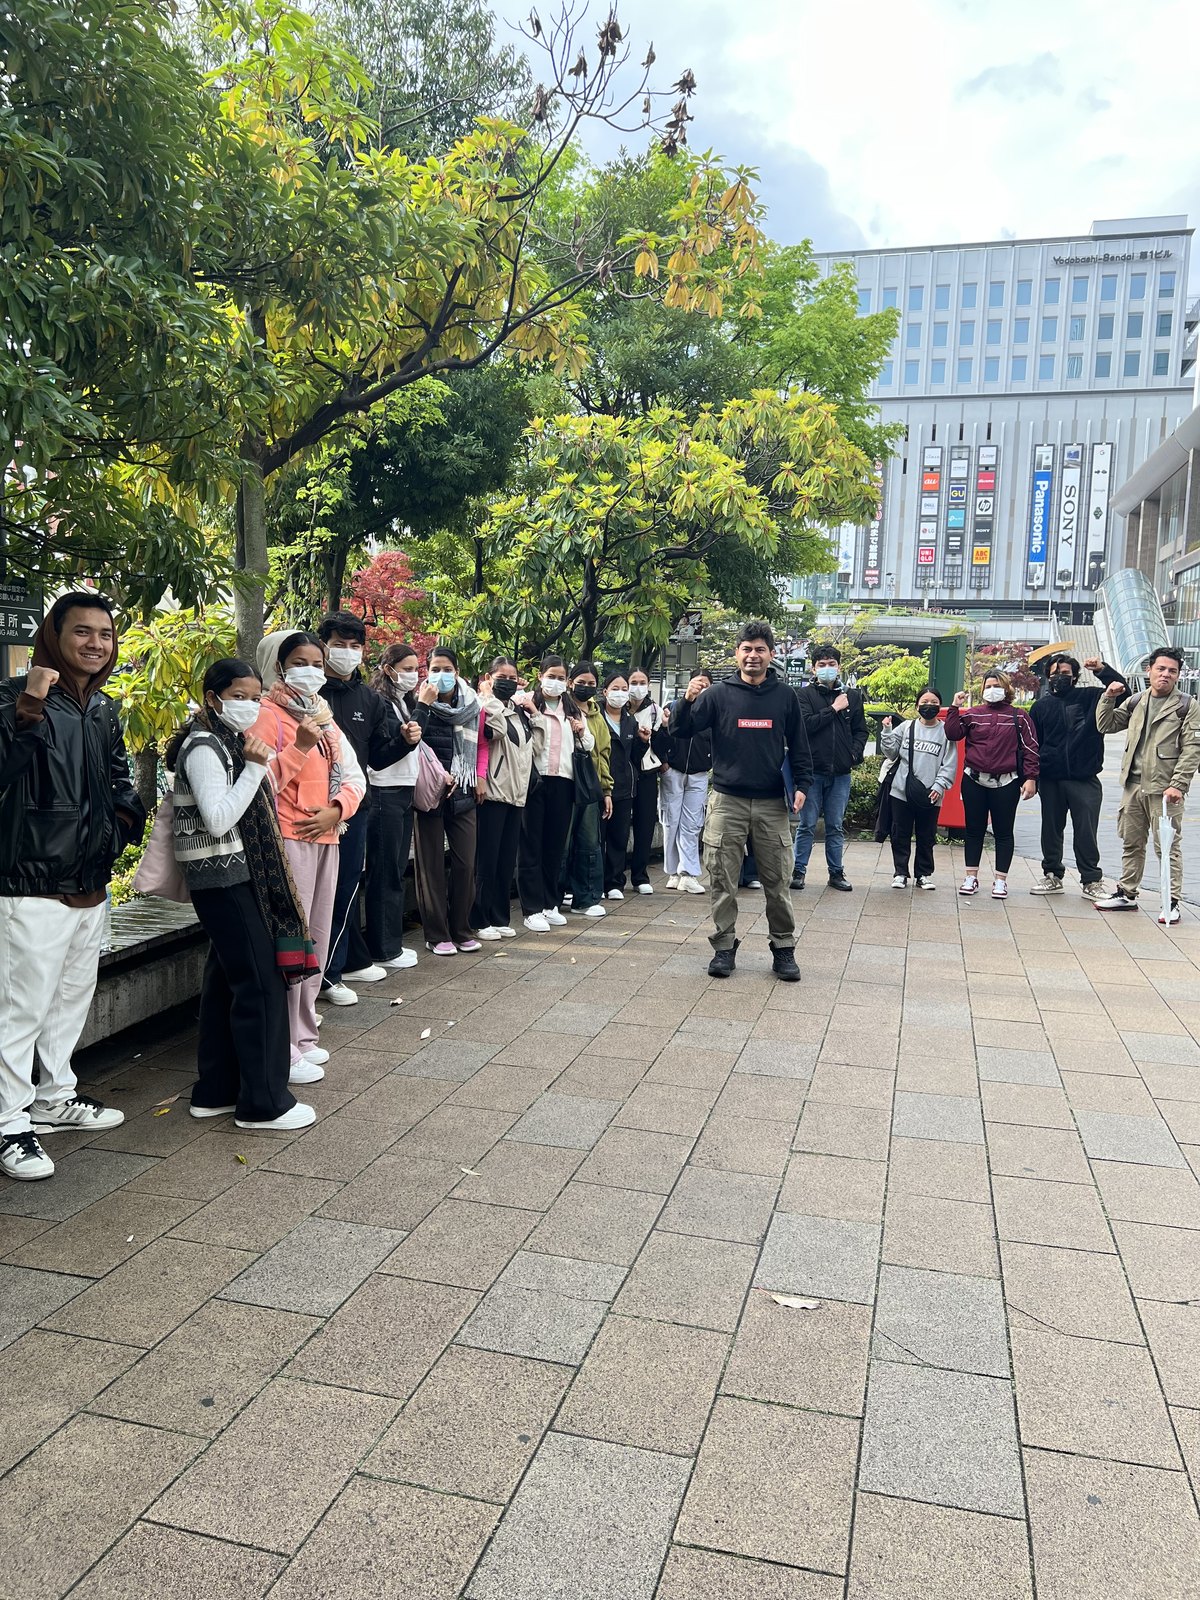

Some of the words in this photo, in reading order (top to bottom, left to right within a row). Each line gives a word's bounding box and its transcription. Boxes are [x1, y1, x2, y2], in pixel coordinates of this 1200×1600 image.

[951, 489, 965, 498] GU
[978, 499, 992, 512] hp
[1031, 480, 1049, 554] Panasonic
[1061, 485, 1077, 549] SONY
[6, 629, 19, 637] AREA
[903, 739, 941, 756] CEATION
